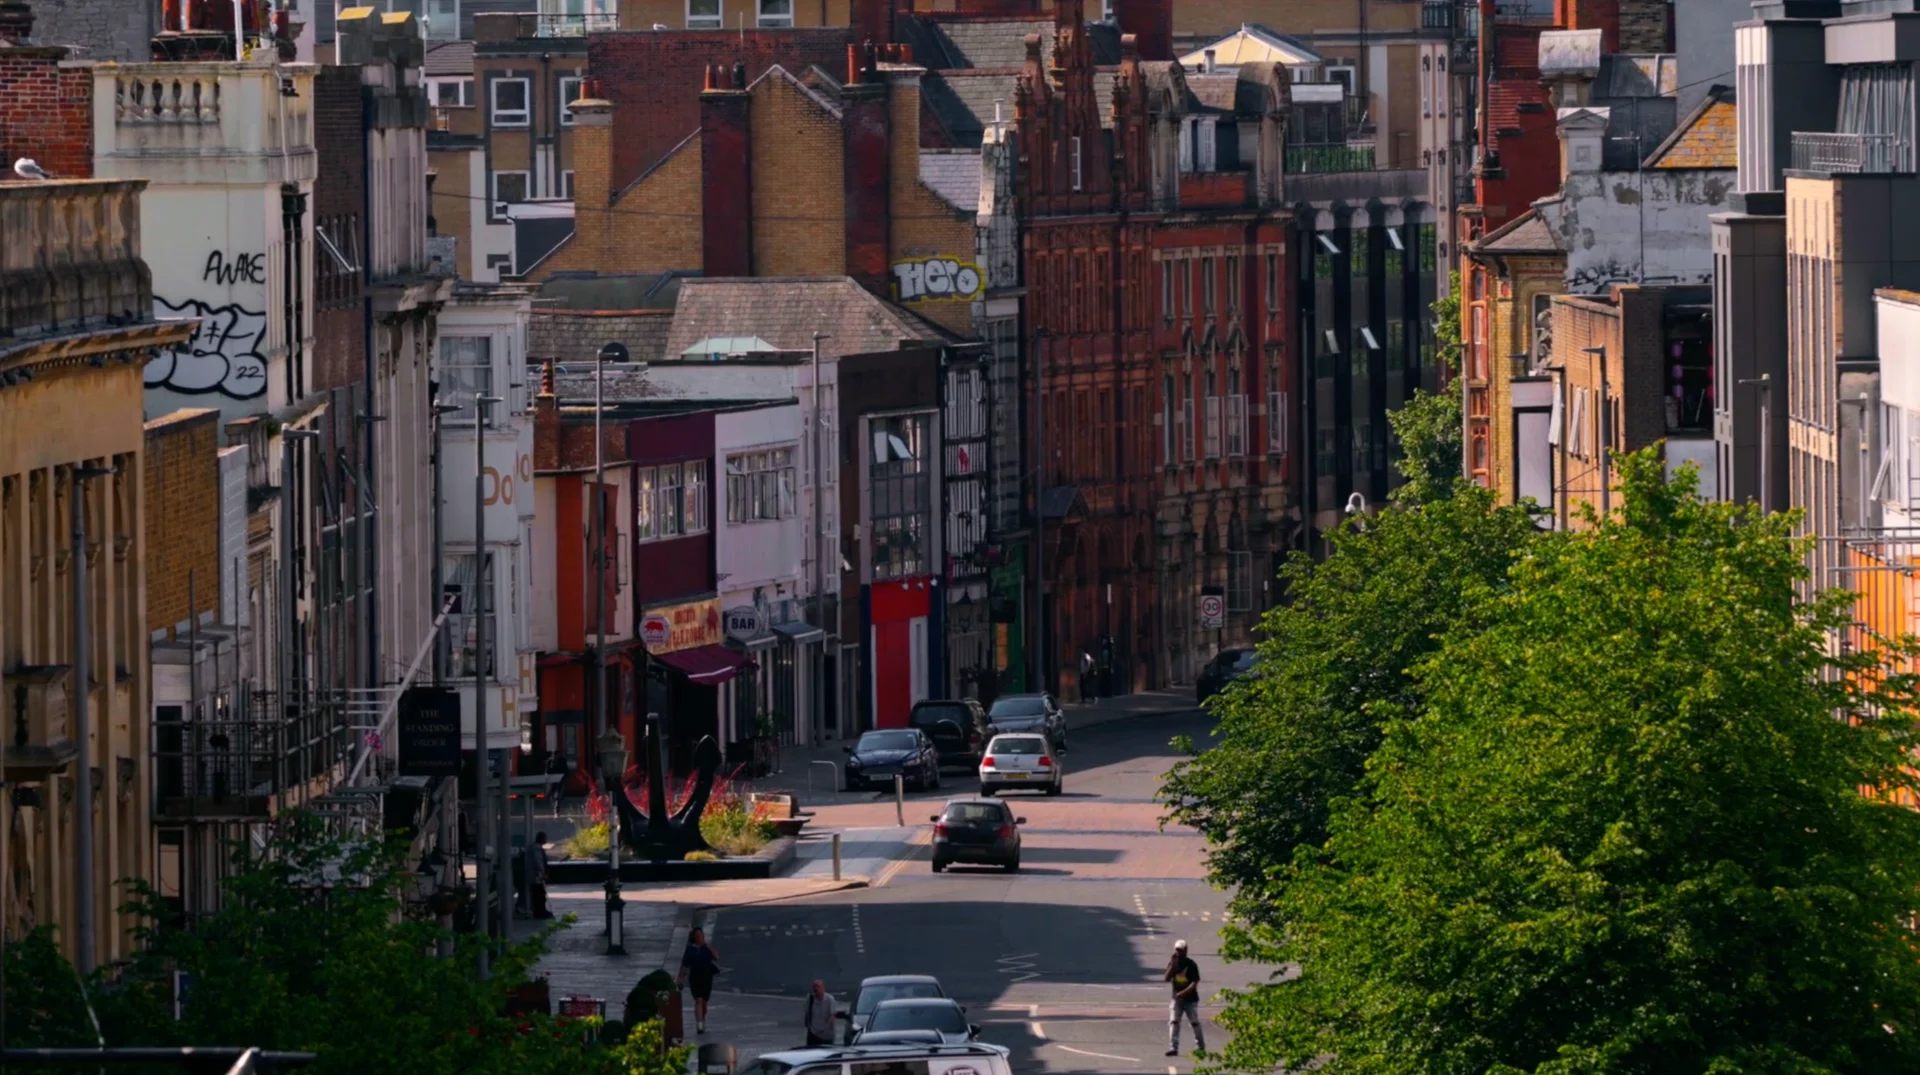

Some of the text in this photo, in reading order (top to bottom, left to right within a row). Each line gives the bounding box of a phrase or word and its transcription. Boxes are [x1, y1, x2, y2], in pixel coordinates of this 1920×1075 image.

[203, 250, 266, 285] AWAKE
[235, 366, 264, 380] 22
[1206, 602, 1218, 611] 30
[731, 617, 755, 630] BAR
[420, 708, 440, 718] THE
